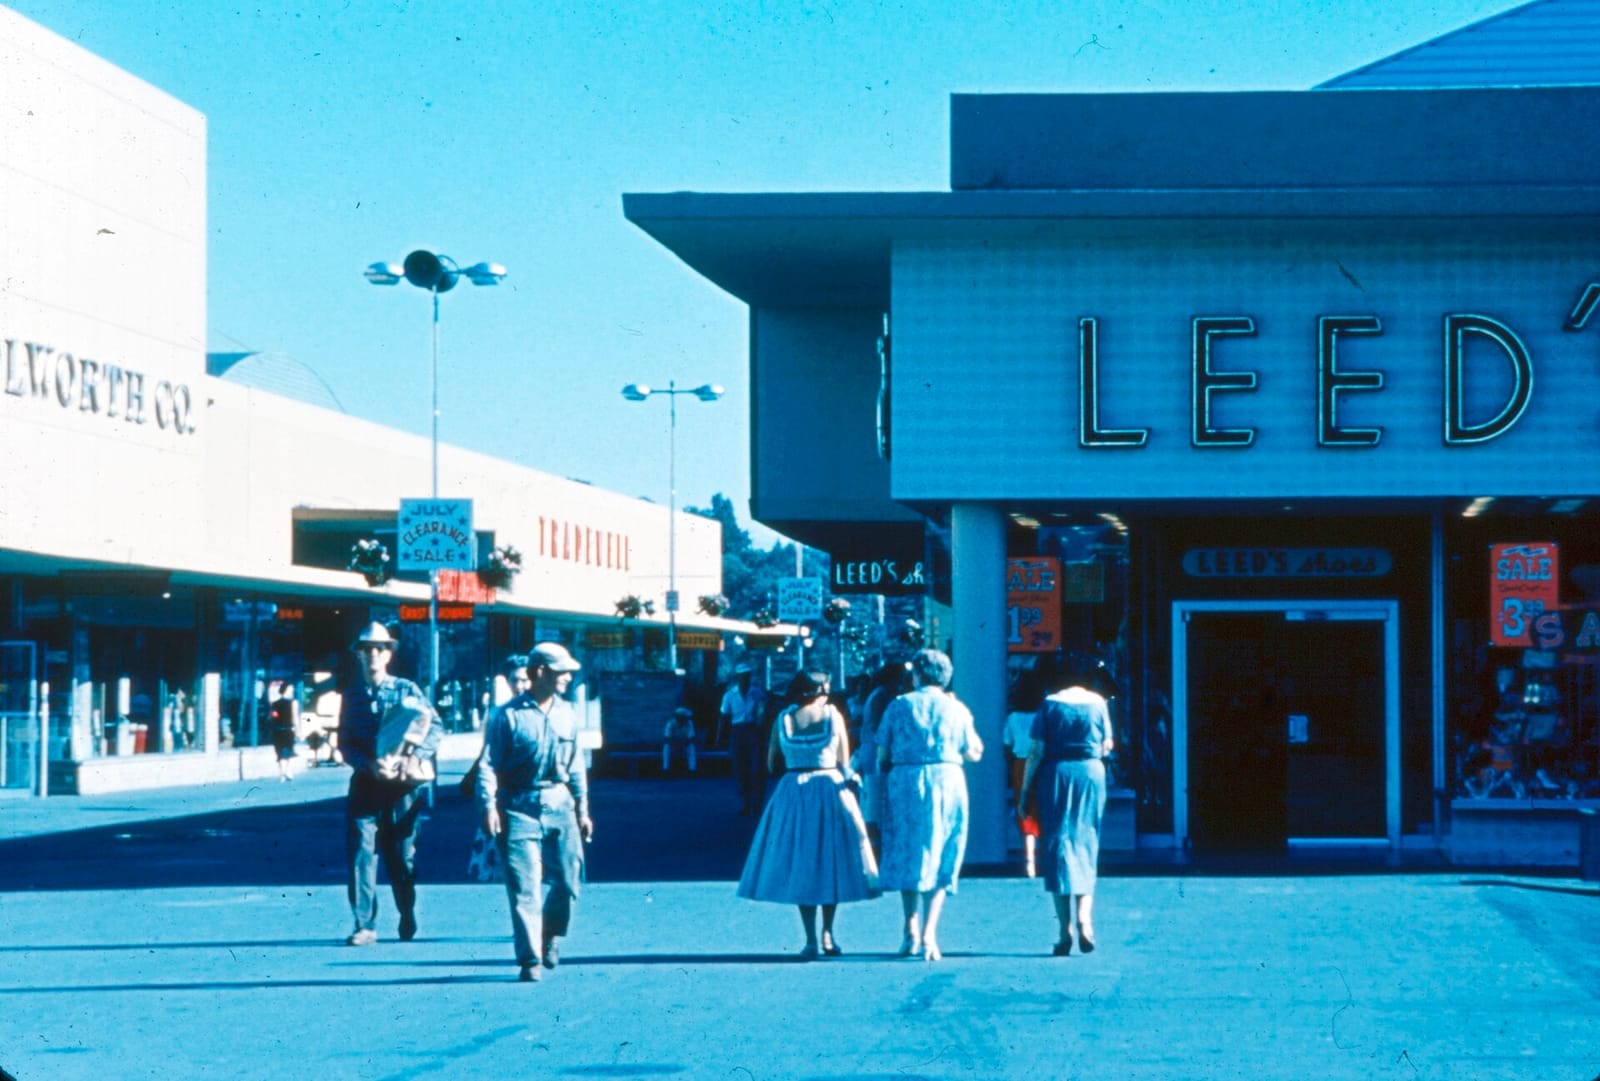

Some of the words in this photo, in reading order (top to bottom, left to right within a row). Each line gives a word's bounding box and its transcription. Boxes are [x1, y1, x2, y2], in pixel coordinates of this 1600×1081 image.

[155, 380, 196, 435] CO.
[410, 504, 458, 515] JULY
[402, 521, 469, 547] CLEARANCE
[413, 549, 454, 562] SALE
[1198, 551, 1288, 573] LEED'S
[1297, 551, 1377, 573] shoes
[836, 560, 898, 585] LEED'S
[1496, 558, 1552, 580] SALE
